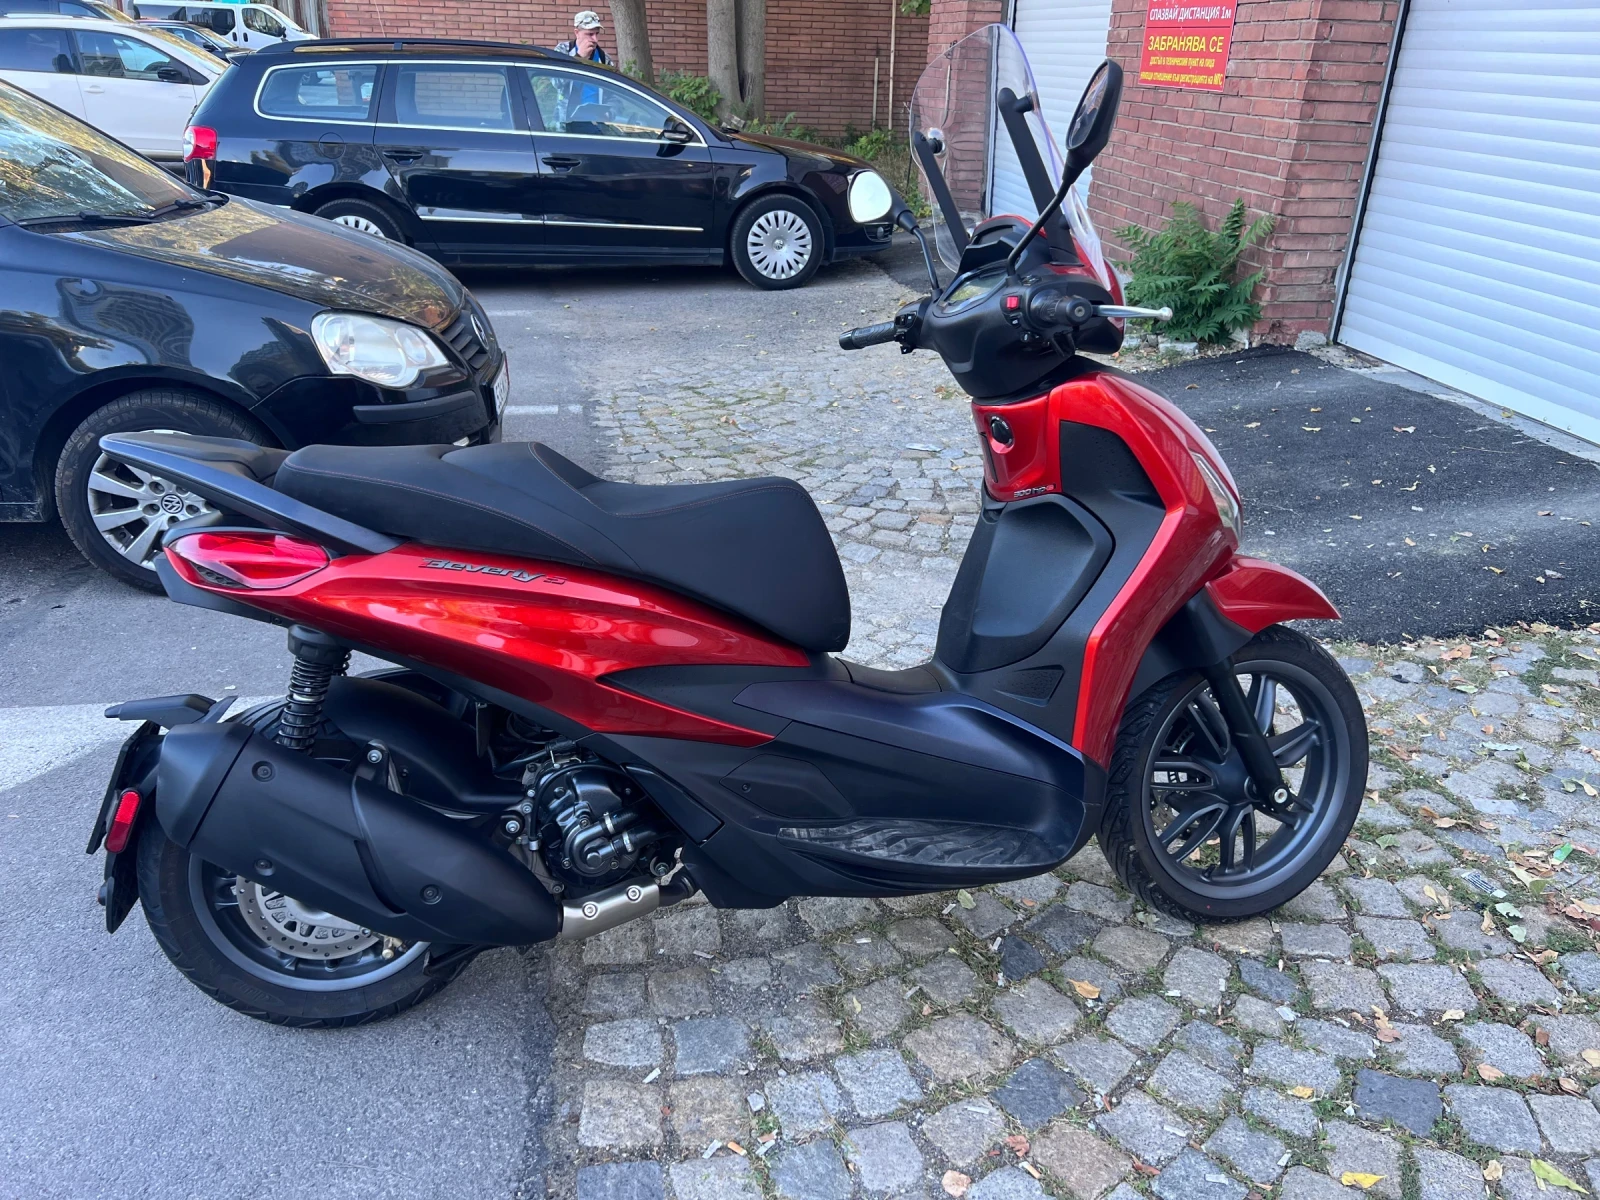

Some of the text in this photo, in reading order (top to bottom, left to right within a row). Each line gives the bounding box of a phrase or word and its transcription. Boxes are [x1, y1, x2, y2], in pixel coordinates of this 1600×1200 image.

[1149, 5, 1179, 21] СПАЗВАЙ
[1178, 6, 1220, 22] ДИСТАНЦИЯ
[1147, 35, 1224, 53] ЗАБРАНЯВА СЕ
[418, 557, 545, 583] Beverly
